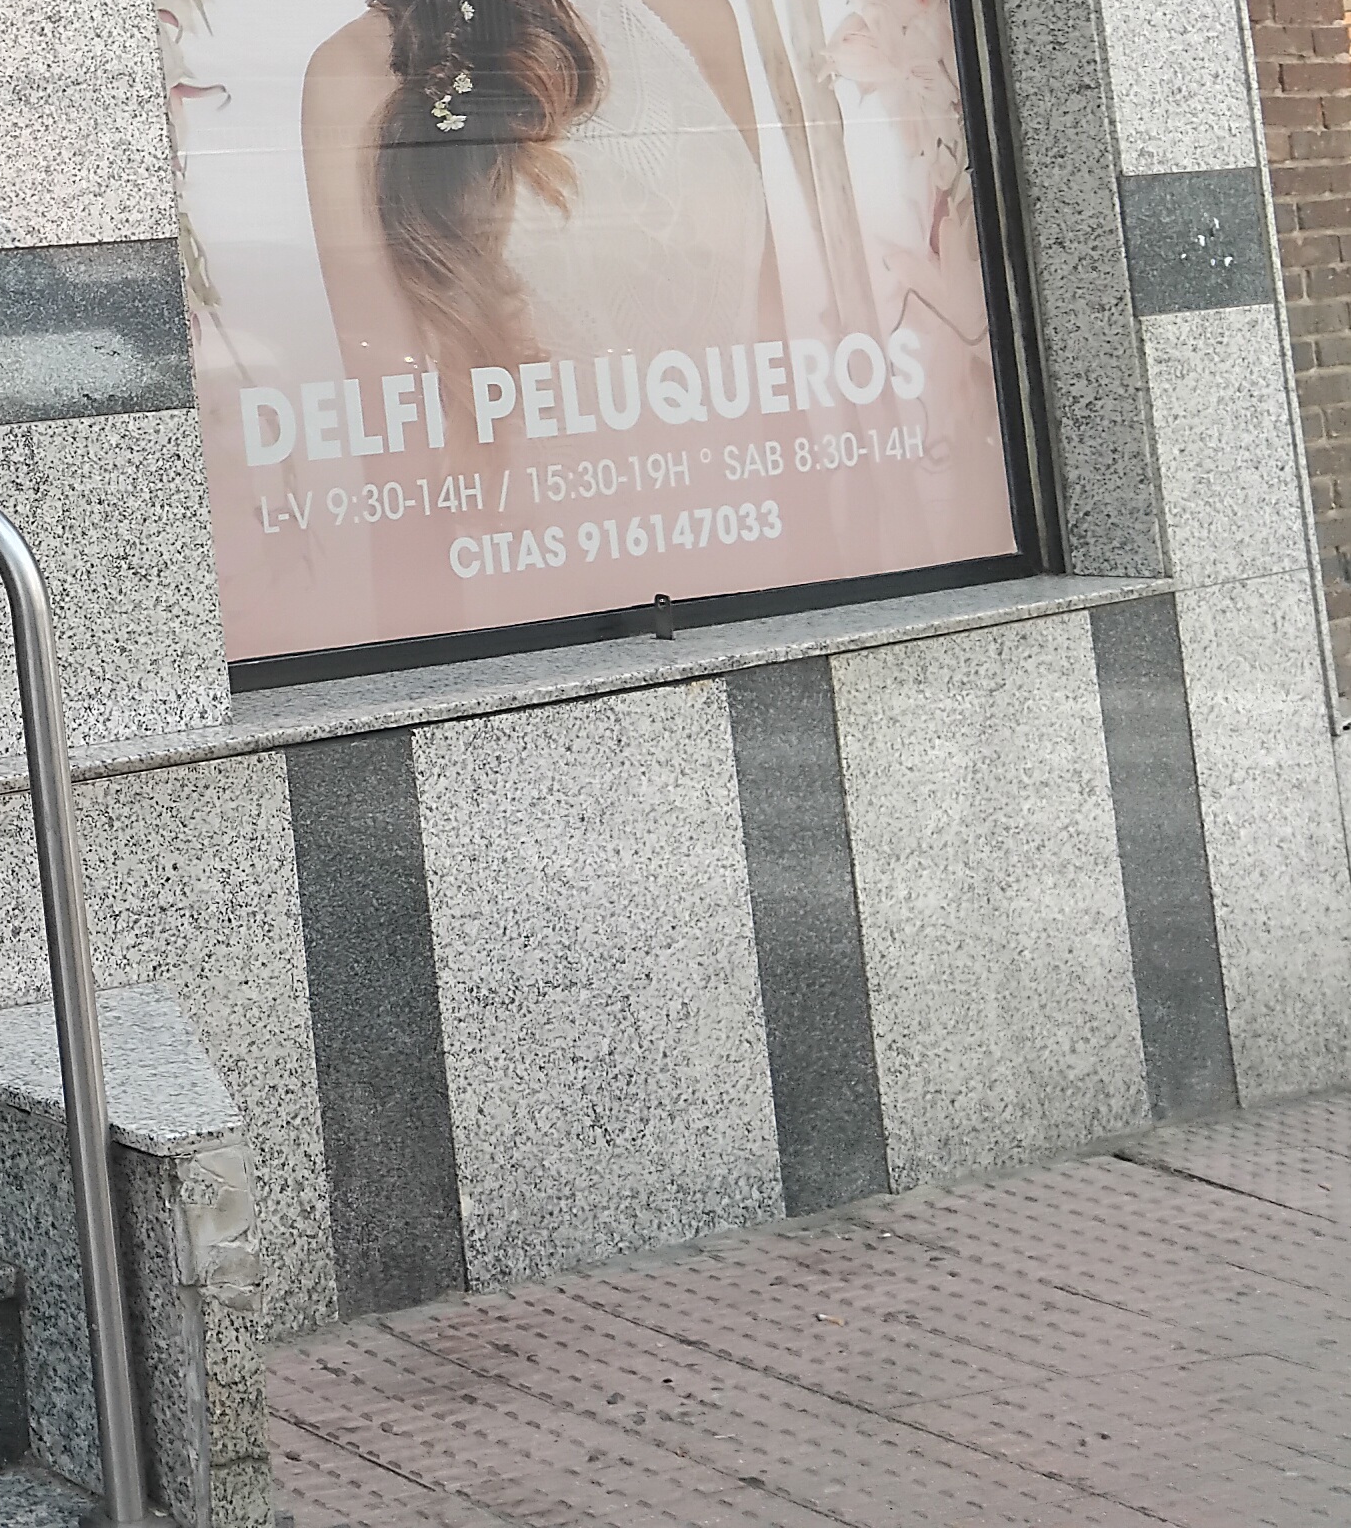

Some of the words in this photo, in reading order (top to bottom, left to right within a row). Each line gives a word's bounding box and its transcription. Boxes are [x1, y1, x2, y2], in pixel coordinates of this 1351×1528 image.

[240, 370, 446, 468] DELFI
[472, 329, 926, 444] PELUQUEROS
[260, 487, 314, 534] L-V
[327, 474, 483, 525] 9:30-14H
[529, 450, 691, 502] 15:30-19H
[723, 440, 784, 483] SAB
[793, 424, 926, 474] 8:30-14H
[449, 526, 567, 579] CITAS
[577, 499, 783, 561] 916147033
